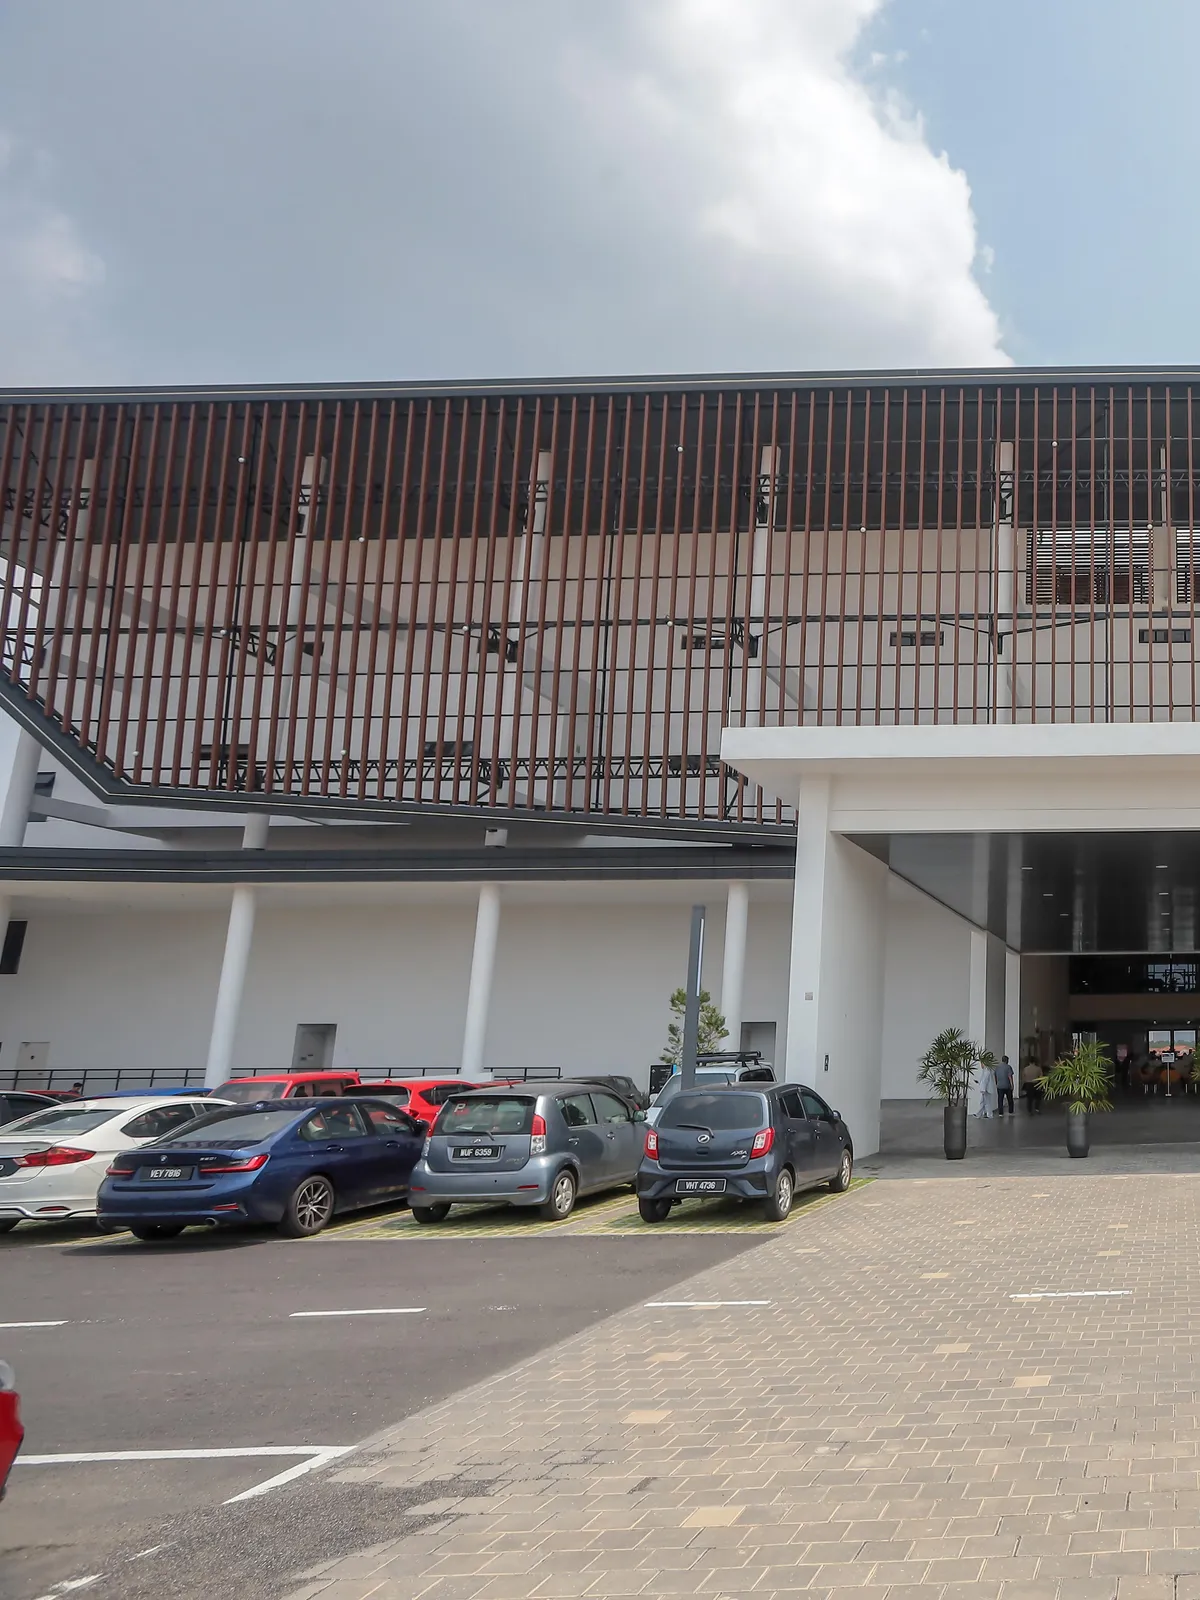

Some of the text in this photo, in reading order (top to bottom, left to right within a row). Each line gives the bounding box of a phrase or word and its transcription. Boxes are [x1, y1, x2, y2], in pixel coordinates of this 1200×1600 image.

[474, 1148, 492, 1156] 6359
[150, 1169, 164, 1178] VEY
[685, 1181, 716, 1189] VHT 4736
